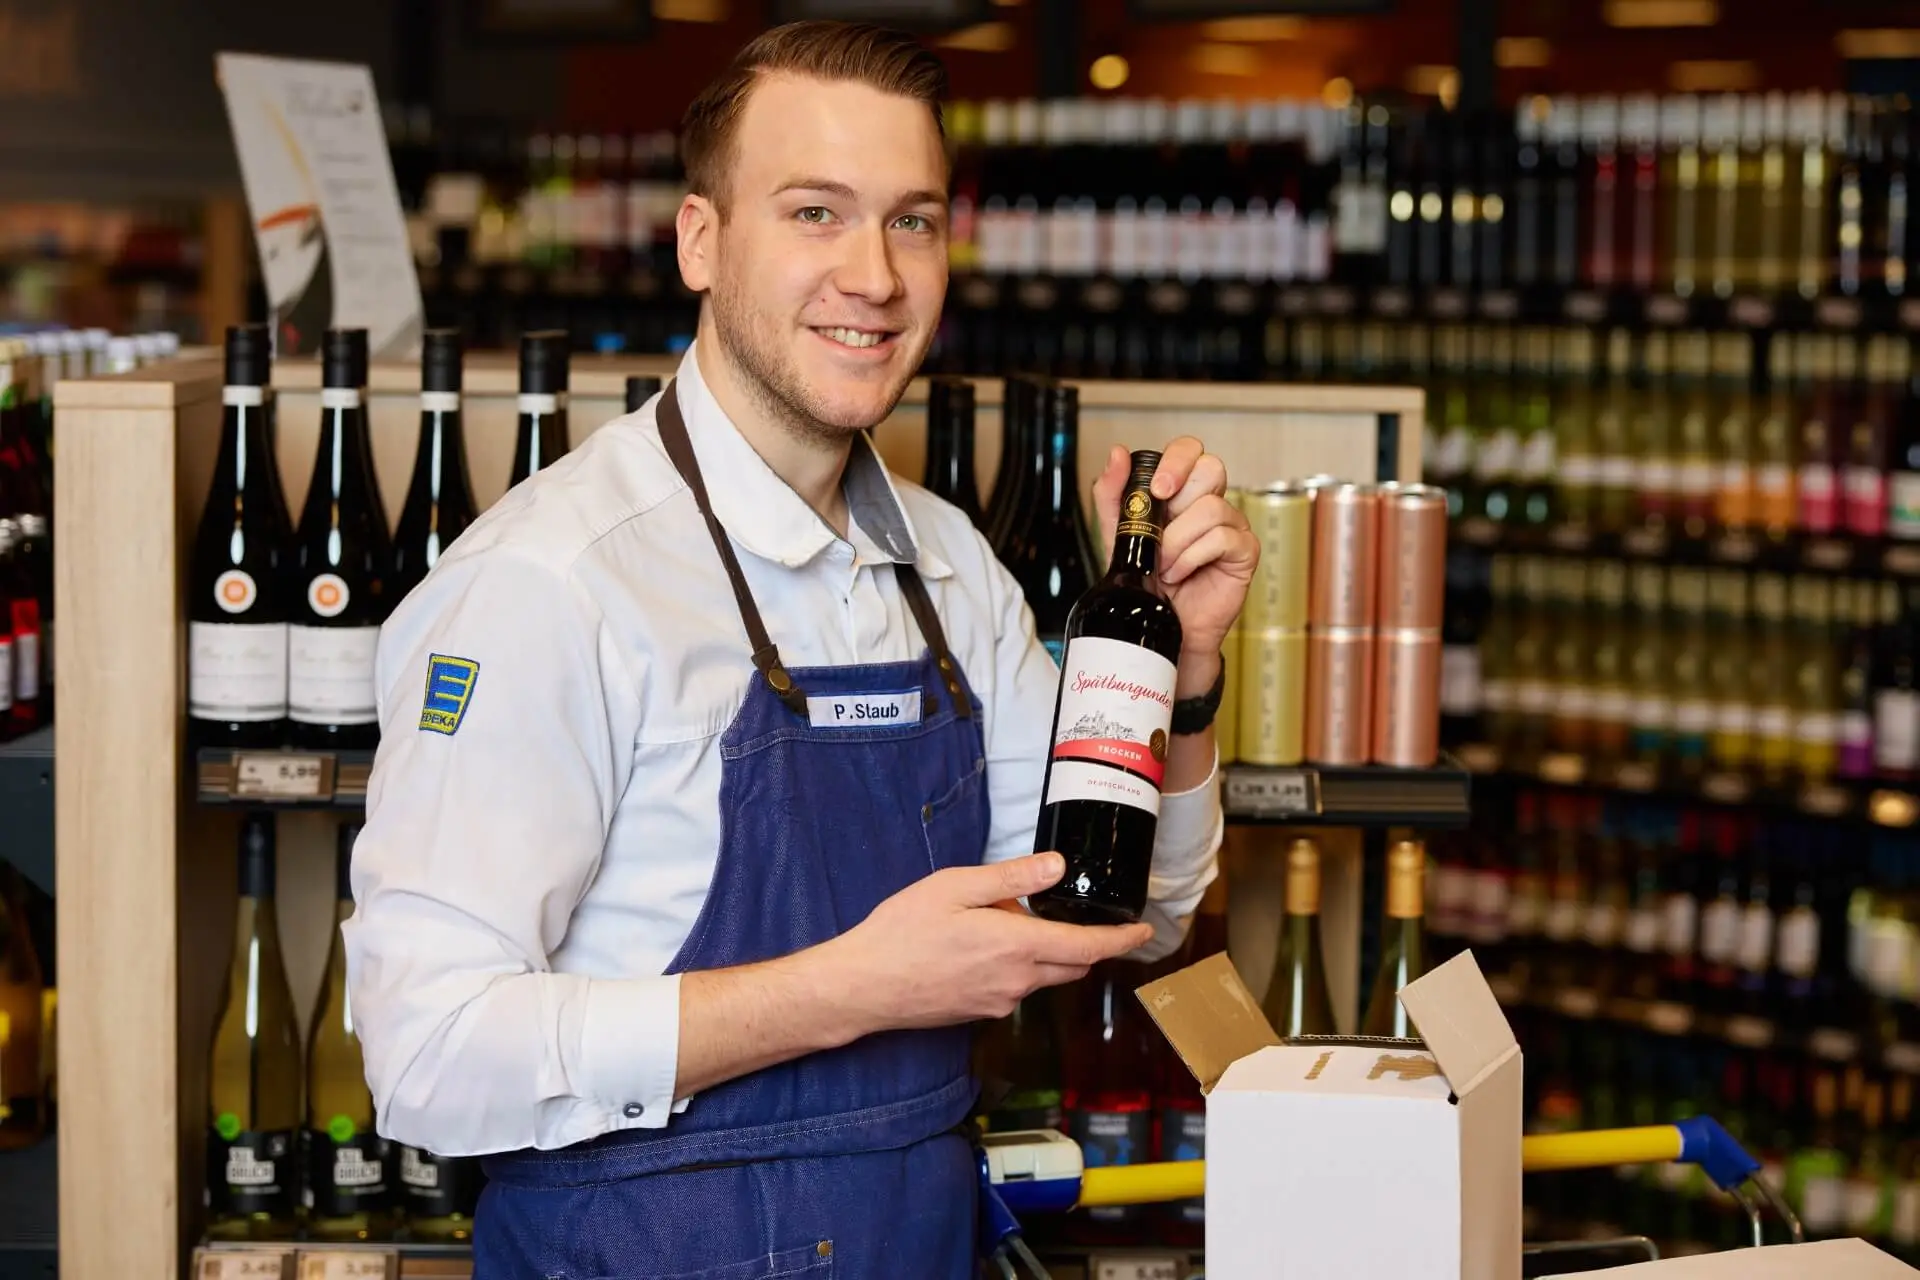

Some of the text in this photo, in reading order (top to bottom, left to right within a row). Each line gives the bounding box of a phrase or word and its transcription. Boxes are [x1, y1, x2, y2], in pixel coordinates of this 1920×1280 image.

[1071, 670, 1173, 710] Spätburgunde
[1097, 744, 1143, 762] TROCKEN
[1087, 778, 1141, 797] DEUTSCHLAND
